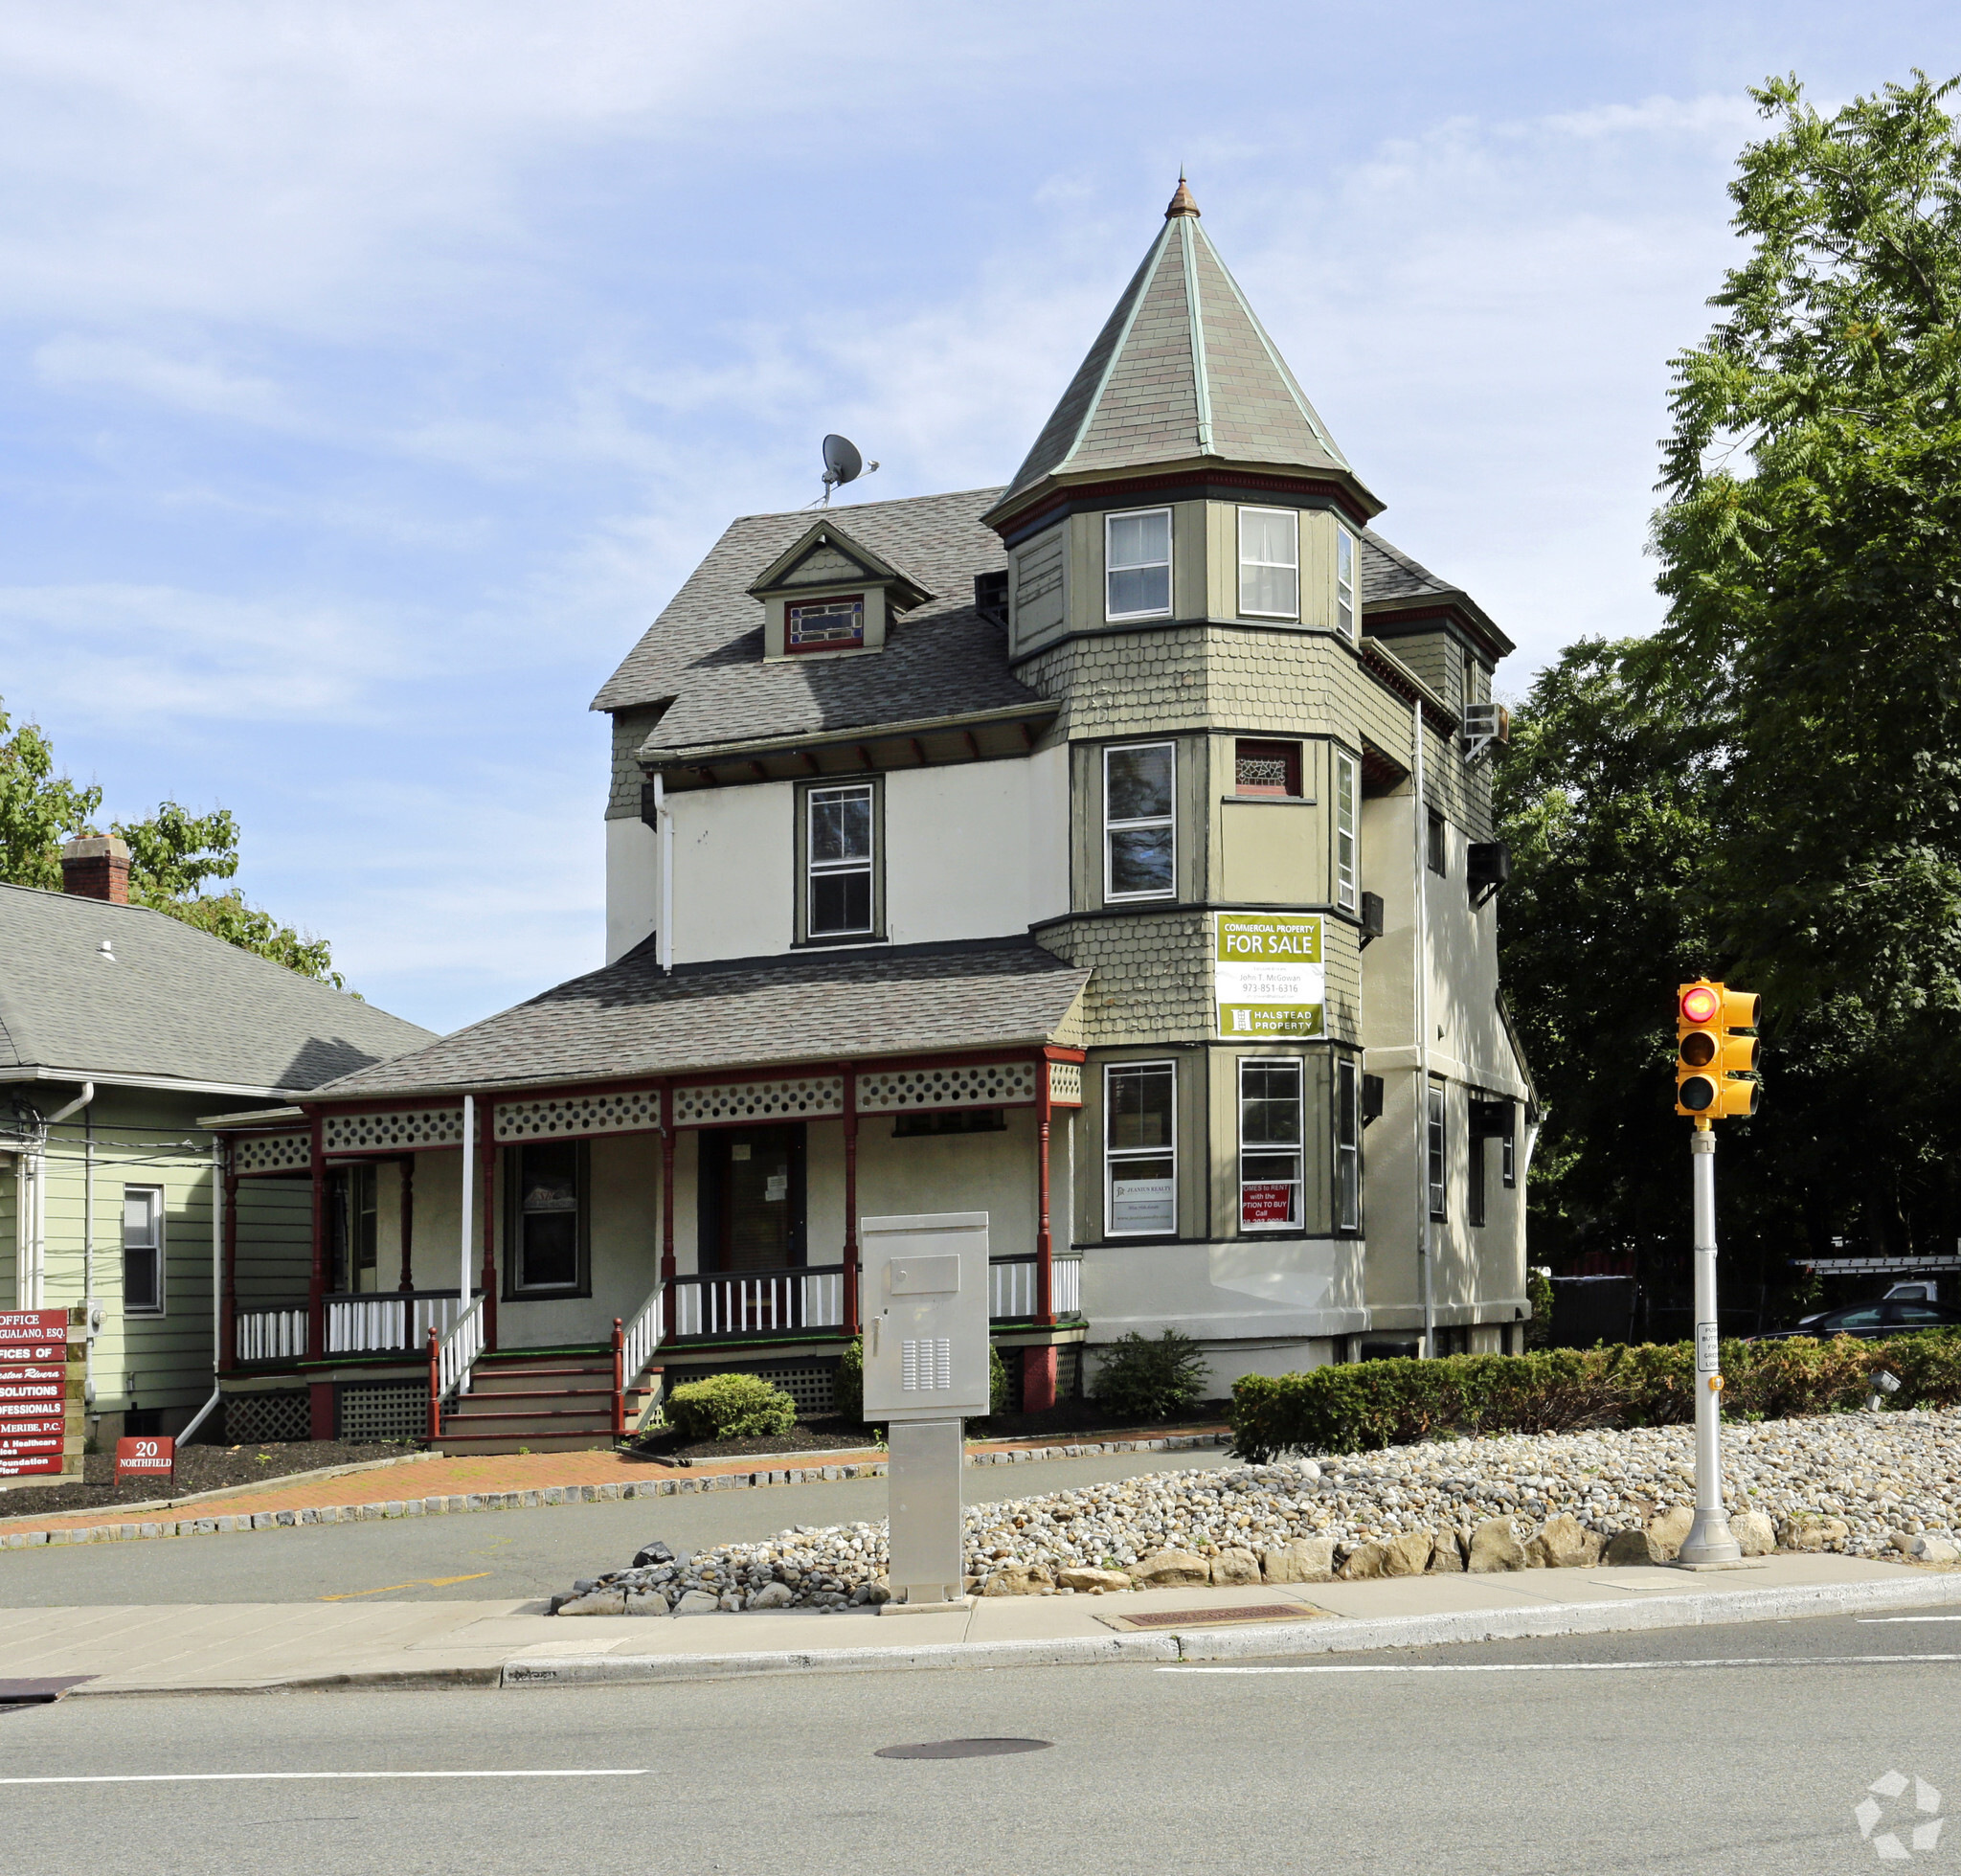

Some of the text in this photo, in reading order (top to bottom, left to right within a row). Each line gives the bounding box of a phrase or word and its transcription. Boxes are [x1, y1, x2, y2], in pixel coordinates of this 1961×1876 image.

[1225, 924, 1275, 932] COMMERCIAL
[1227, 935, 1313, 954] FOR SALE
[1243, 983, 1298, 992] 973-851-6316
[1255, 1021, 1312, 1030] PROPERTY
[0, 1315, 39, 1325] OFFICE
[46, 1328, 65, 1339] ESQ.
[36, 1348, 52, 1358] OF
[24, 1368, 59, 1378] Rivera
[0, 1386, 58, 1397] SOLUTIONS
[1, 1423, 61, 1433] MERIBE, P.C.
[136, 1442, 158, 1457] 20
[120, 1458, 172, 1467] NORTHFIELD
